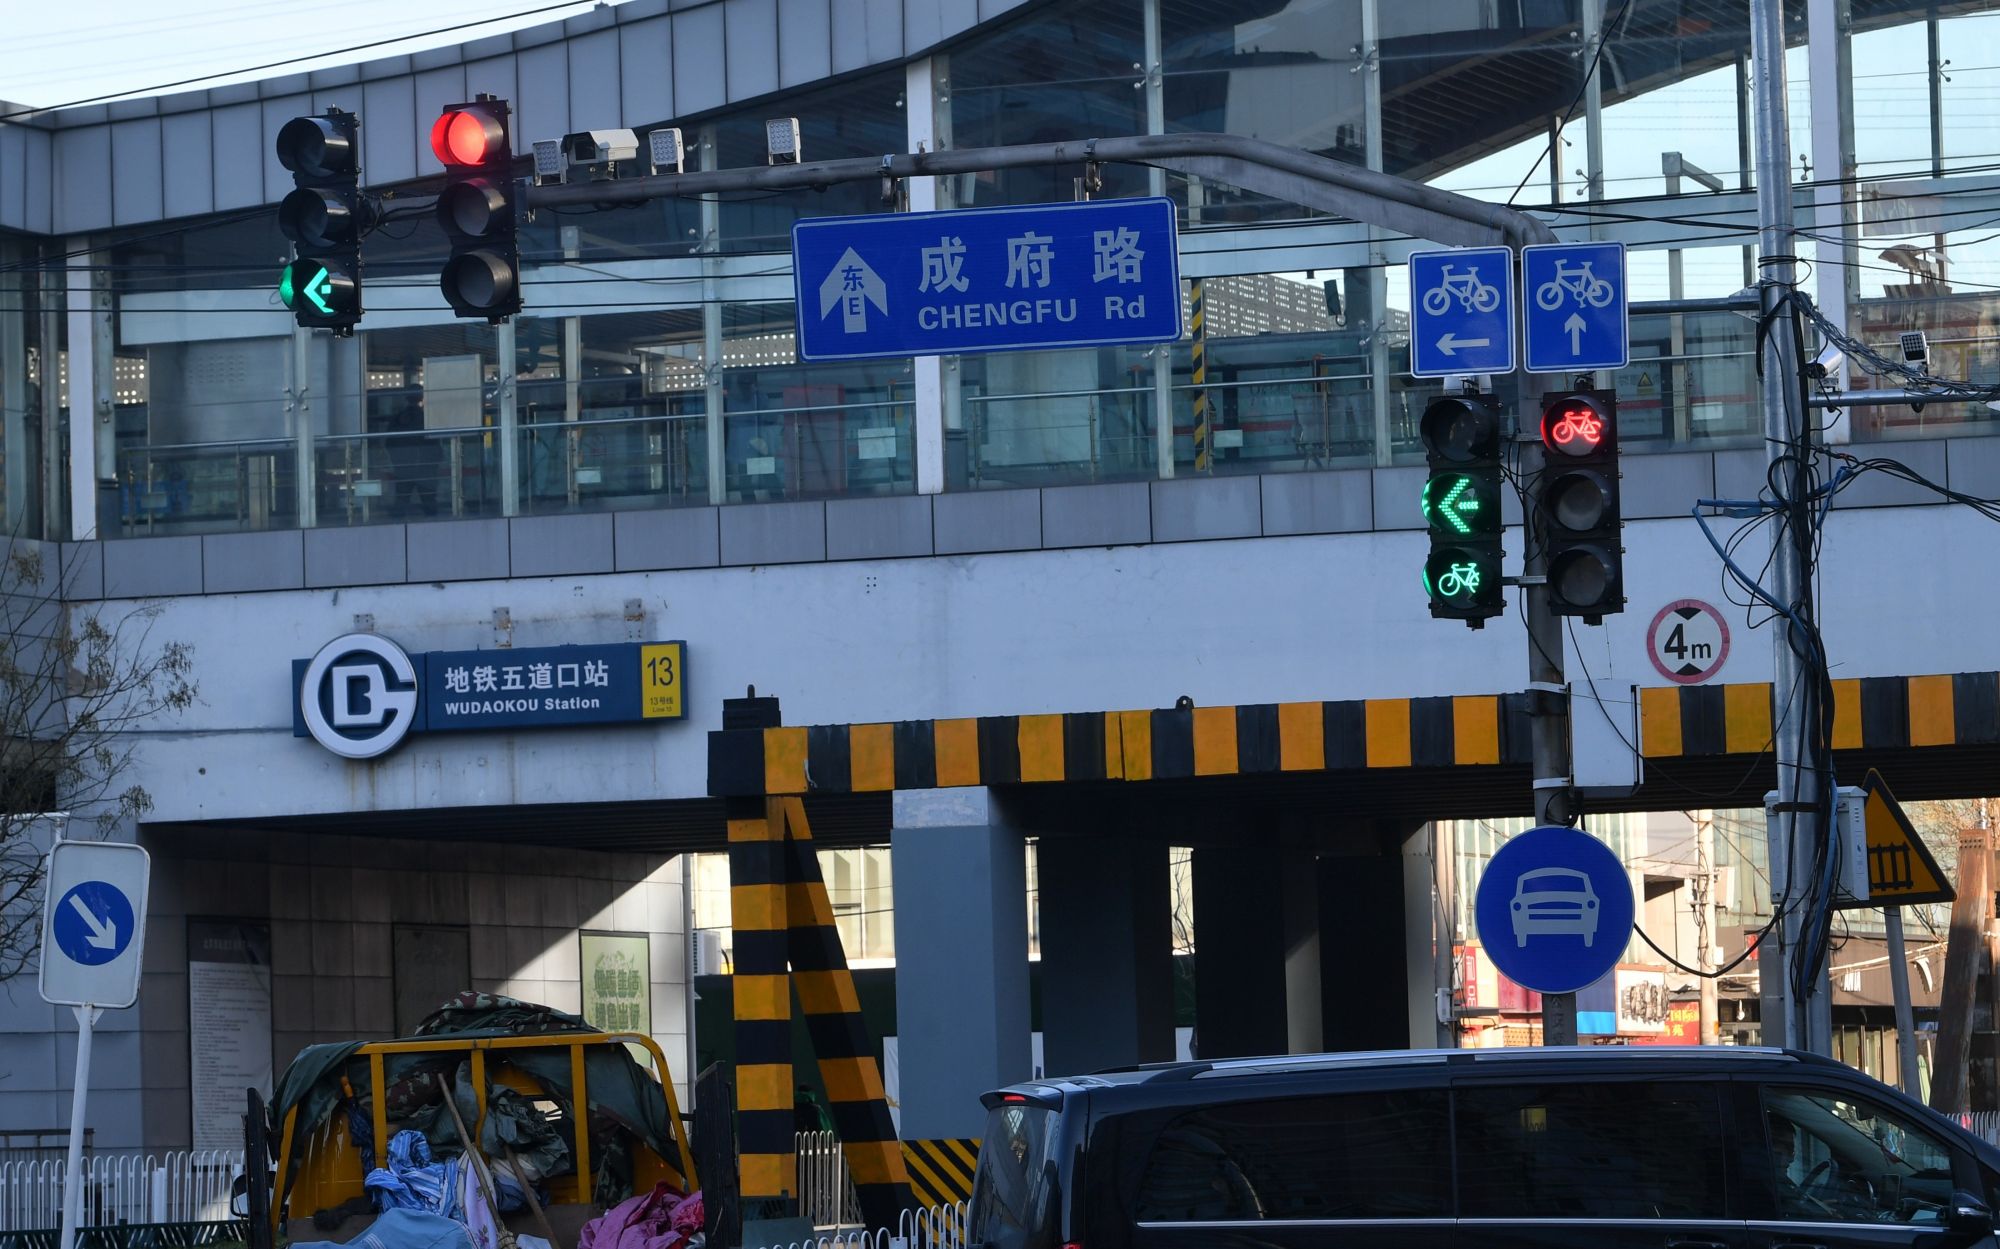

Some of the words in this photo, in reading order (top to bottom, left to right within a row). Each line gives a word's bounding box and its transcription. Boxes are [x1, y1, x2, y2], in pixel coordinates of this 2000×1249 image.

[918, 226, 1145, 293] 成府路
[841, 265, 864, 292] 东
[848, 297, 860, 316] E
[918, 299, 1077, 330] CHENGFU
[1105, 295, 1145, 319] Rd
[664, 623, 711, 660] 4m
[445, 661, 609, 693] 地铁五道口站
[647, 656, 674, 687] 13
[445, 698, 538, 716] WUDAOKOU
[544, 697, 600, 711] Station
